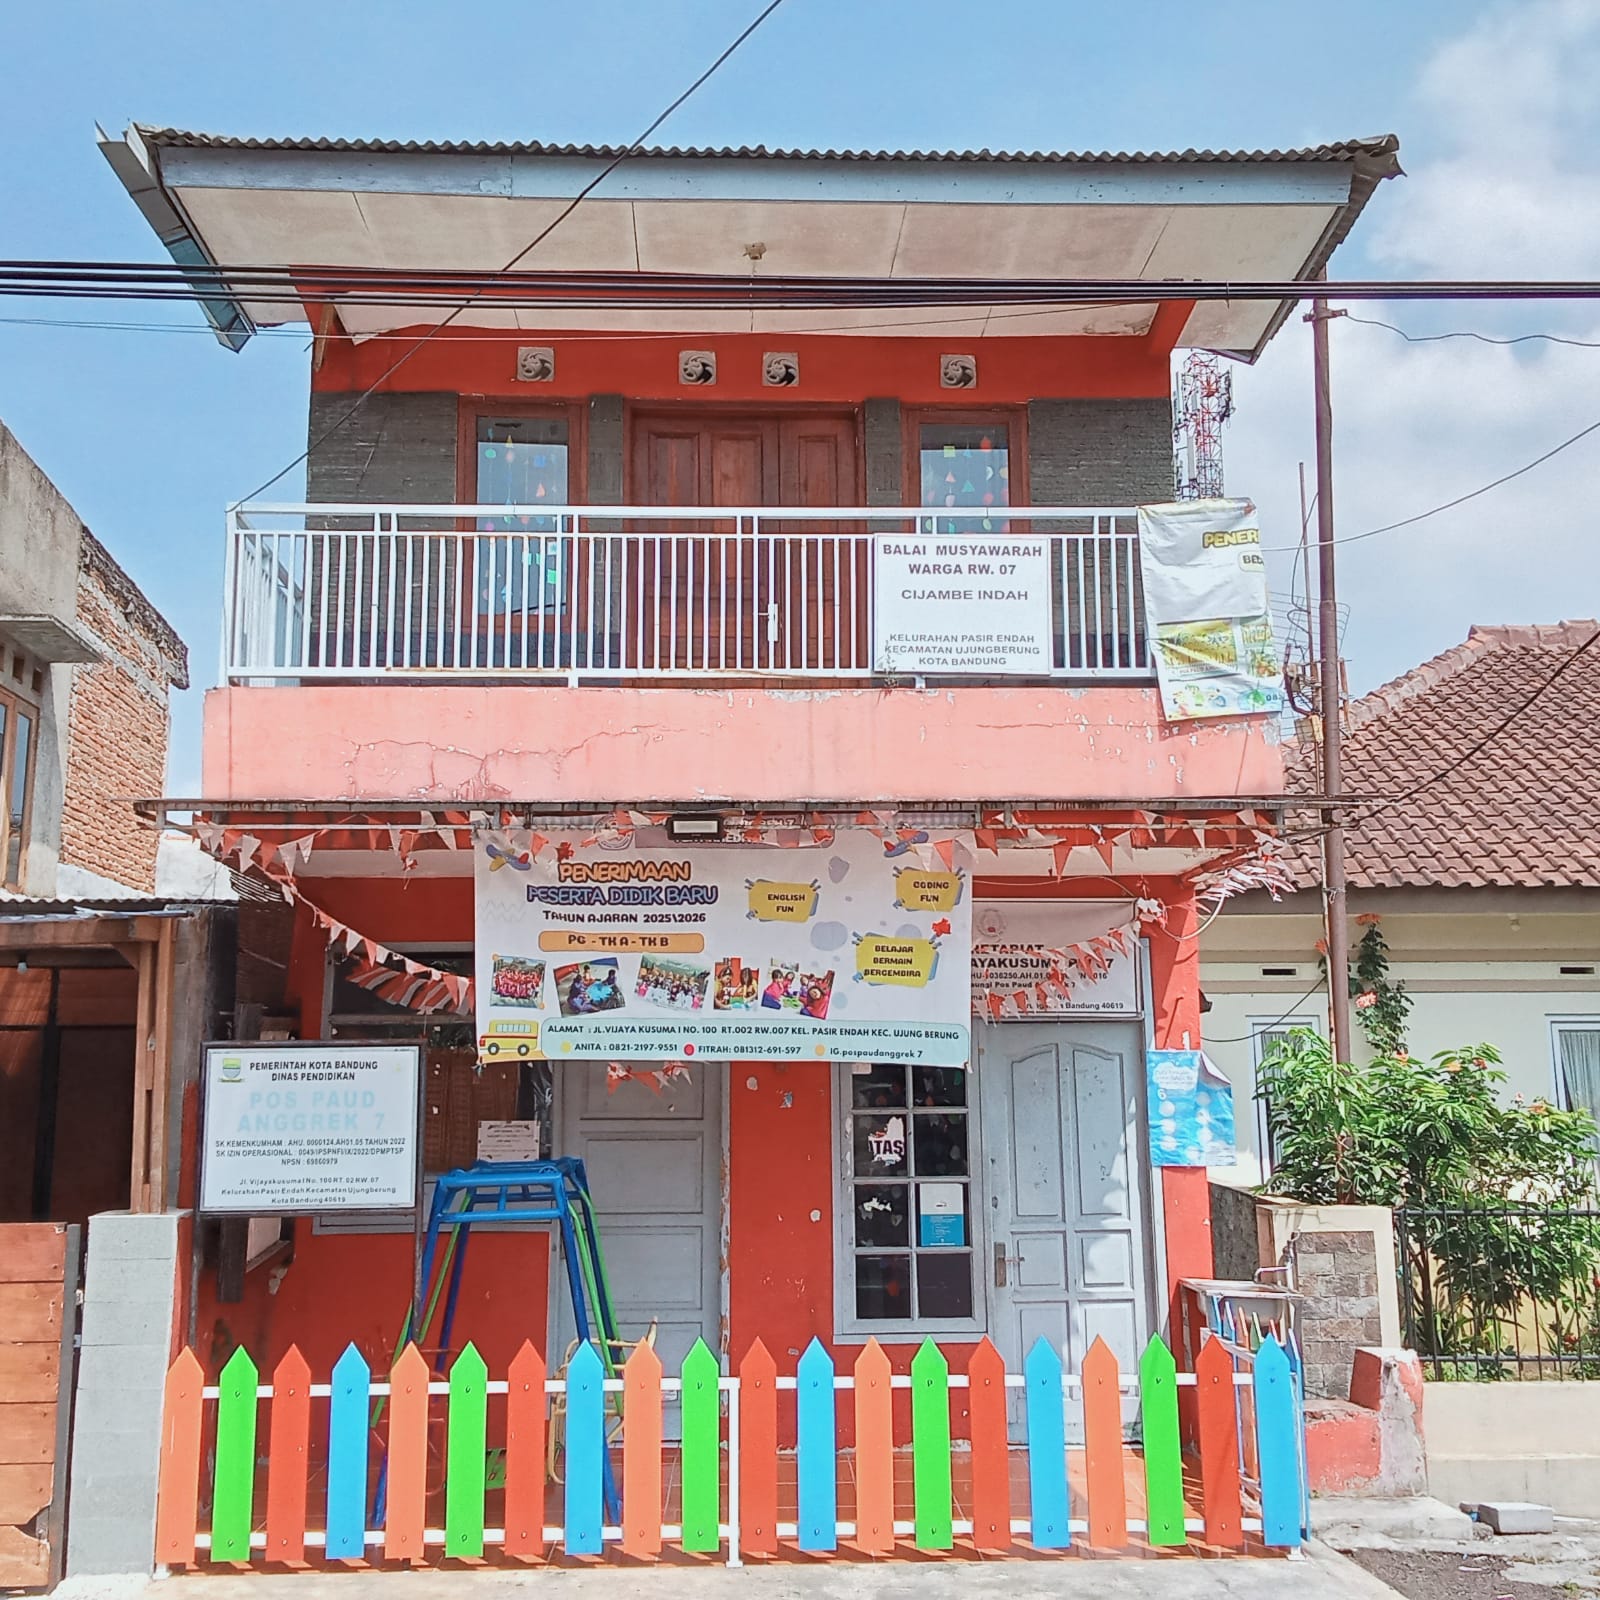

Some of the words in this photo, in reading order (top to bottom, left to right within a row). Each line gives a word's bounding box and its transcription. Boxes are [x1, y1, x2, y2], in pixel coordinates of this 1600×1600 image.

[883, 544, 927, 556] BALAI
[936, 545, 1042, 557] MUSYAWARAH
[908, 563, 963, 575] WARGA
[968, 563, 994, 575] RW.
[999, 564, 1017, 575] 07
[901, 589, 973, 600] CIJAMBE
[978, 590, 1028, 600] INDAH
[889, 633, 958, 643] KELURAHAN
[961, 634, 994, 643] PASIR
[997, 634, 1035, 643] ENDAH
[884, 645, 953, 654] KECAMATAN
[955, 646, 1040, 655] UJUNGBERUNG
[918, 657, 949, 665] KOTA
[951, 657, 1007, 666] BANDUNG
[558, 860, 691, 883] PENERIMAAN
[913, 881, 949, 889] CODING
[527, 885, 605, 905] PESERTA
[608, 886, 663, 905] DIDIK
[665, 885, 718, 904] BARU
[767, 893, 806, 901] ENGLISH
[920, 894, 939, 902] FUN
[542, 910, 585, 923] TAHUN
[587, 913, 638, 923] AJARAN
[599, 937, 617, 946] TK
[619, 937, 629, 946] A
[639, 937, 657, 946] TK
[659, 937, 669, 947] B
[875, 945, 913, 953] BELAJAR
[873, 957, 912, 965] BERMAIN
[864, 968, 921, 977] BERGEMBIRA
[1065, 1002, 1100, 1010] Bandung
[548, 1025, 584, 1033] ALAMAT
[639, 1026, 676, 1034] KUSUMA
[683, 1026, 700, 1034] NO.
[702, 1026, 717, 1034] 100
[721, 1026, 753, 1034] RT.002
[755, 1026, 789, 1034] RW.007
[791, 1027, 810, 1035] KEL.
[812, 1028, 837, 1036] PASIR
[840, 1028, 869, 1036] ENDAH
[871, 1028, 892, 1037] KEC.
[894, 1029, 922, 1038] UJUNG
[924, 1031, 959, 1039] BERUNG
[574, 1043, 602, 1051] ANITA
[609, 1043, 677, 1051] 0821-2197-9551
[698, 1045, 731, 1053] FITRAH:
[734, 1046, 801, 1054] 081312-691-597
[917, 1050, 923, 1058] 7
[250, 1061, 306, 1070] PEMERINTAH
[309, 1061, 333, 1070] KOTA
[334, 1060, 378, 1070] BANDUNG
[272, 1072, 298, 1081] DINAS
[301, 1072, 355, 1081] PENDIDIKAN
[250, 1091, 297, 1109] POS
[311, 1090, 376, 1108] PAUD
[239, 1113, 358, 1132] ANGGREK
[375, 1112, 385, 1131] 7
[226, 1139, 283, 1147] KEMENKUMHAM
[365, 1138, 388, 1146] TAHUN
[390, 1137, 405, 1145] 2022
[868, 1140, 904, 1155] TAS
[227, 1149, 240, 1157] IZIN
[242, 1149, 293, 1157] OPERASIONAL
[348, 1186, 396, 1194] Ujungberung
